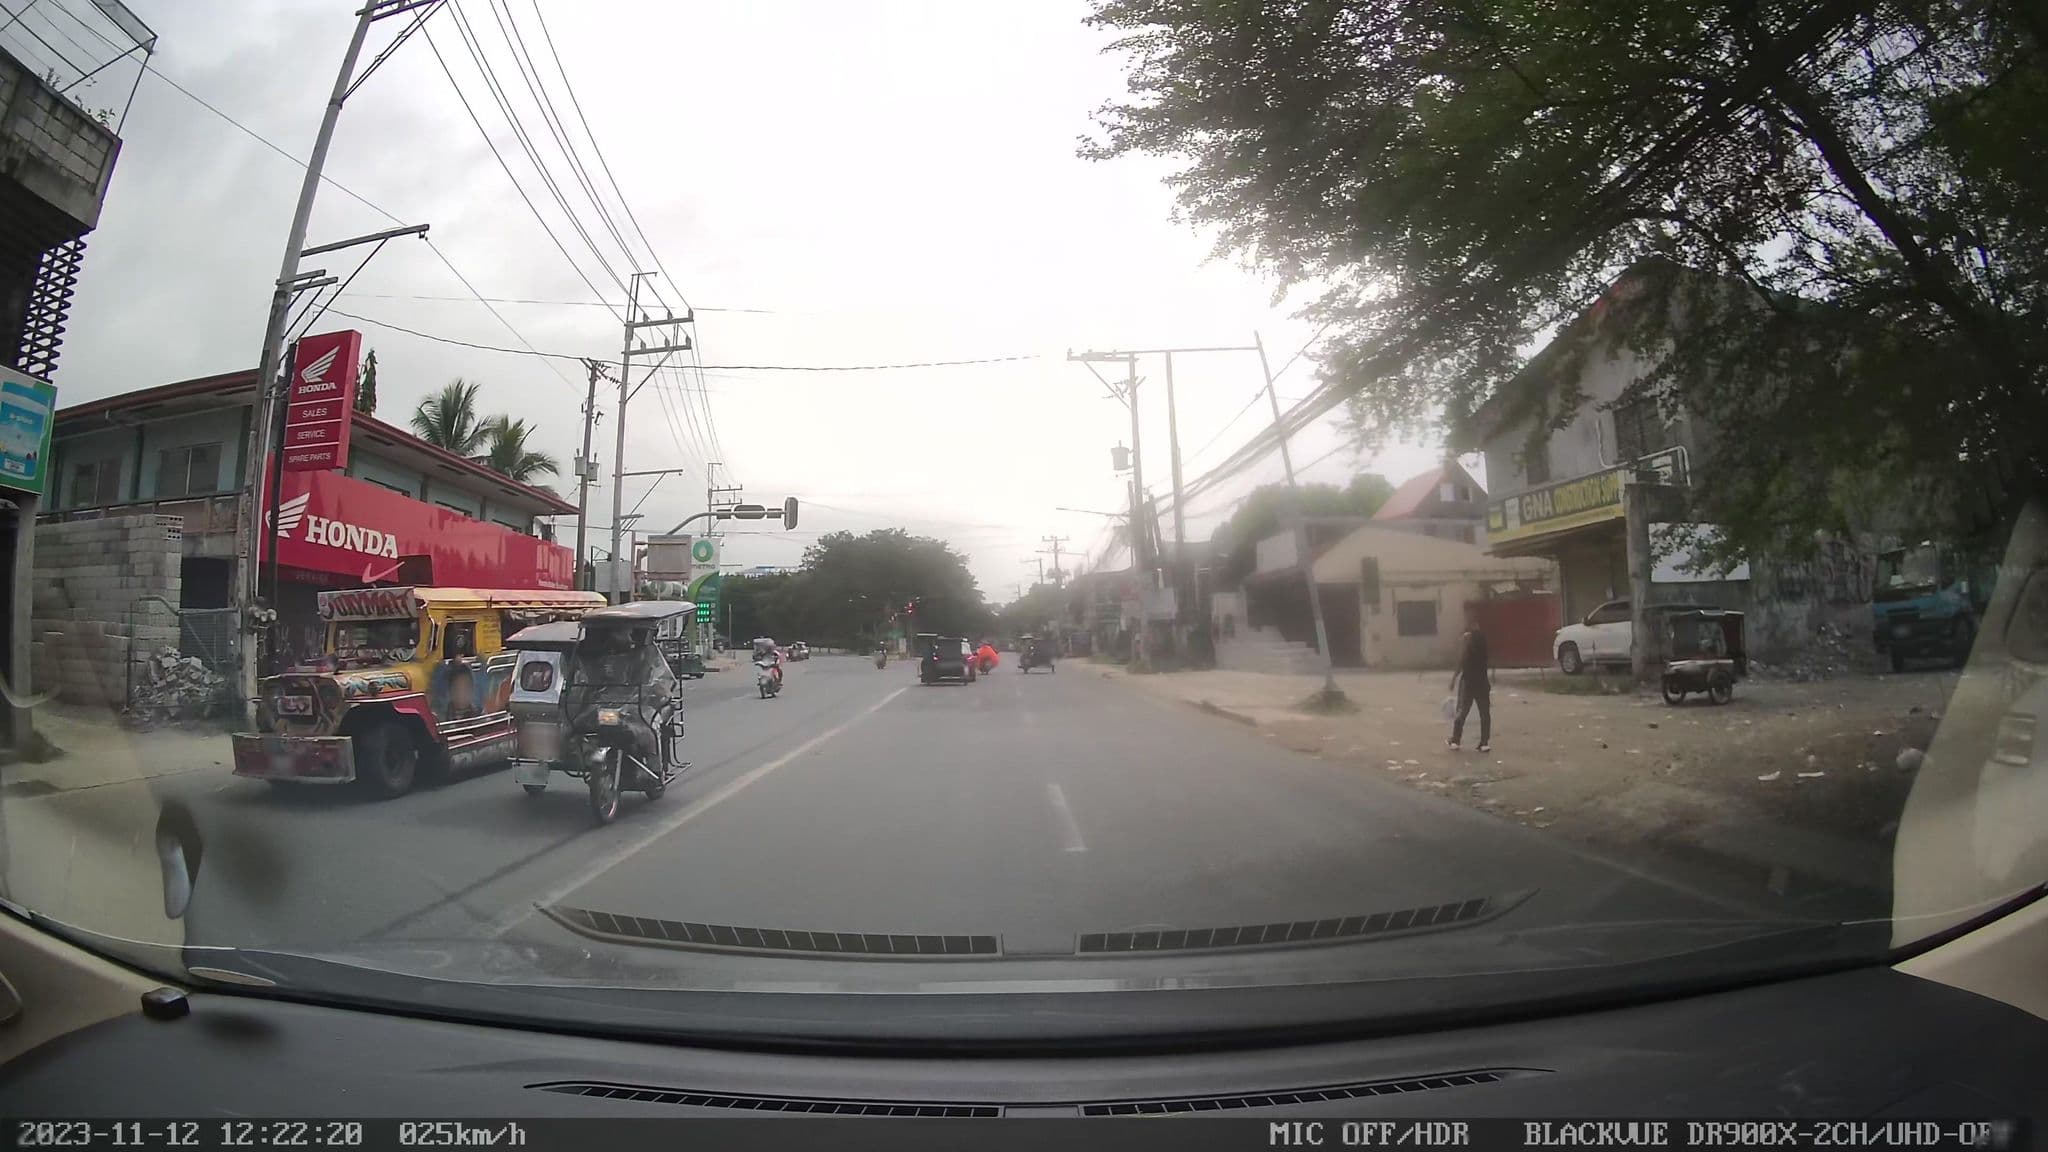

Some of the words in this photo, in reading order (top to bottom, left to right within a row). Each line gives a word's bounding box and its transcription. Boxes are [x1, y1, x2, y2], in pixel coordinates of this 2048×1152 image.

[298, 382, 337, 394] HONDA
[302, 407, 328, 418] SALES
[297, 429, 326, 440] SERVICE
[288, 453, 309, 463] SPARE
[310, 451, 331, 461] PARTS
[1521, 489, 1552, 522] GNA
[304, 514, 399, 559] HONDA
